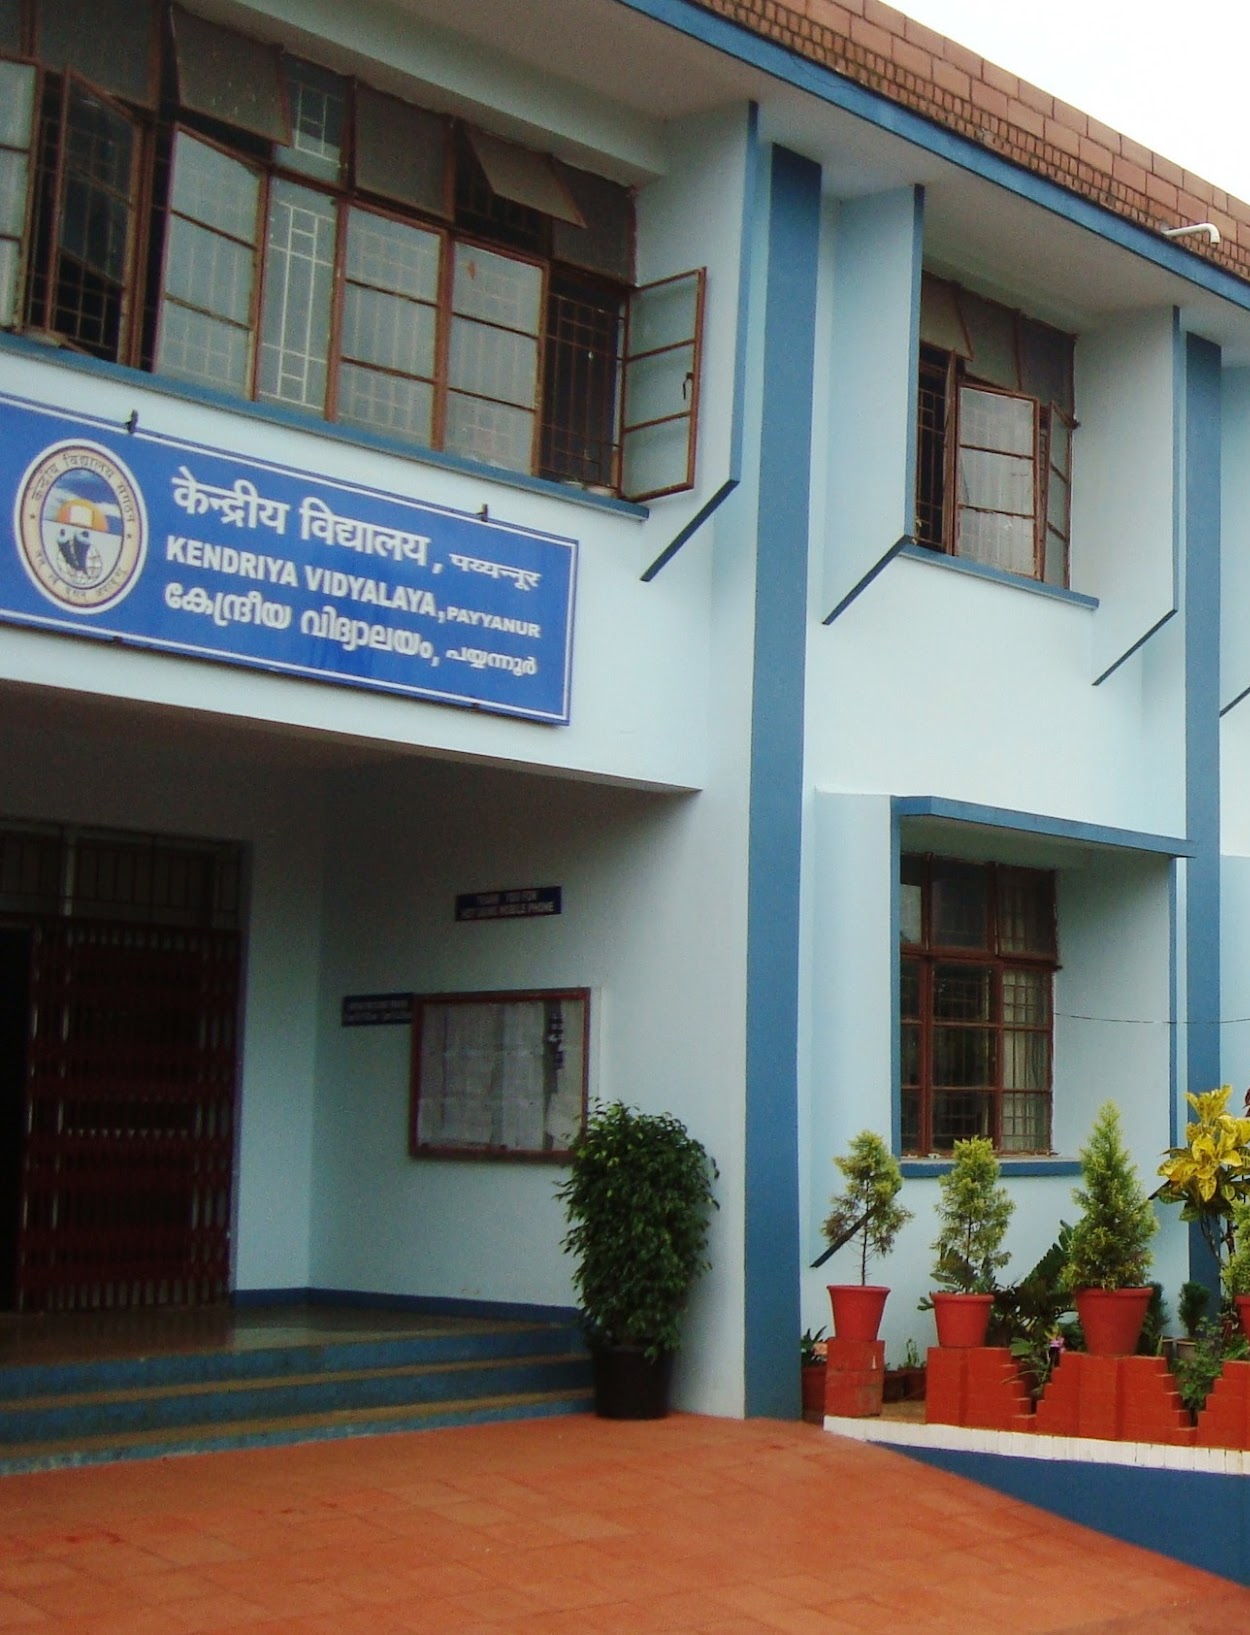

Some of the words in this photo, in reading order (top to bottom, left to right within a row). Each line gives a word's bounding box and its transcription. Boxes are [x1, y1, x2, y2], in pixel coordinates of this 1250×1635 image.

[171, 465, 290, 535] केन्द्रीय
[166, 535, 299, 587] KENDRIYA
[304, 564, 445, 624] VIDYALAYA,
[447, 606, 541, 639] PAYYANUR
